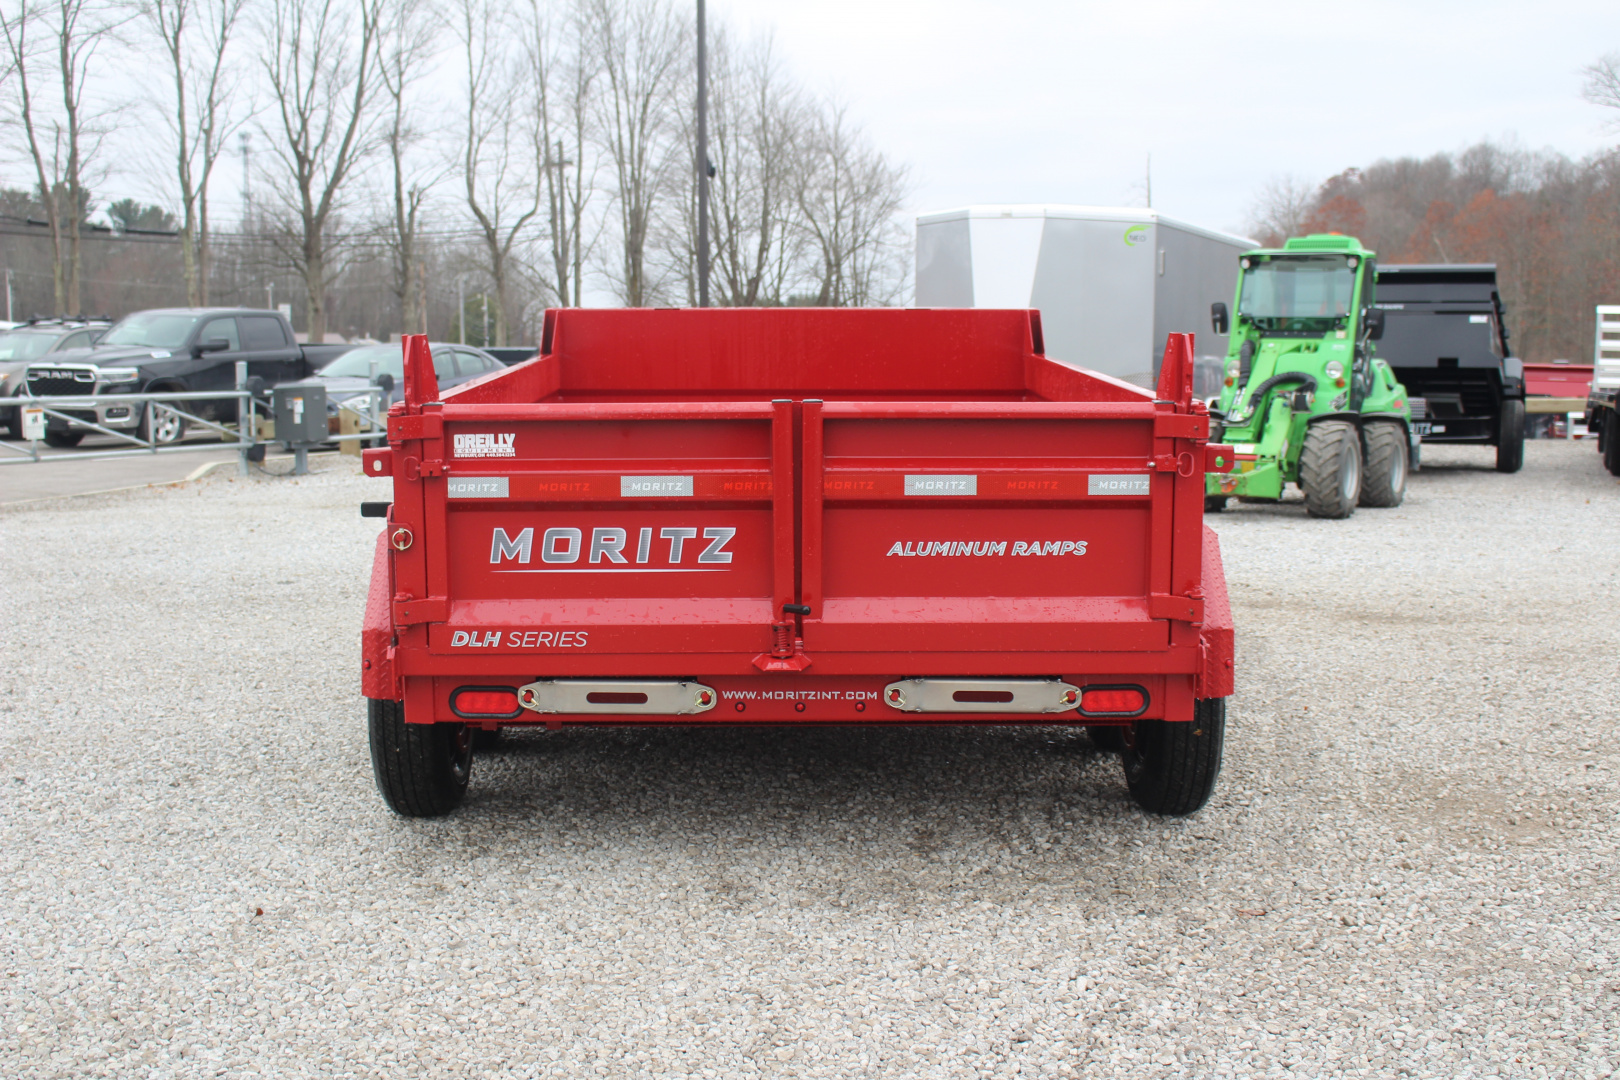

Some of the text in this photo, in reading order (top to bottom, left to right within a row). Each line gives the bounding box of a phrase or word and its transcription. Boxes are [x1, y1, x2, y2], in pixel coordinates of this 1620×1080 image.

[38, 371, 73, 379] RAM
[448, 482, 773, 492] MORITZ MORITZ MORITZ MORITZ
[824, 481, 1150, 490] MORITZ MORITZ MORITZ MORITZ
[489, 527, 737, 564] MORITZ
[886, 541, 1089, 556] ALUMINUM RAMPS
[451, 631, 589, 648] DLH SERIES
[722, 691, 878, 700] WWW.MORITZINT.COM
